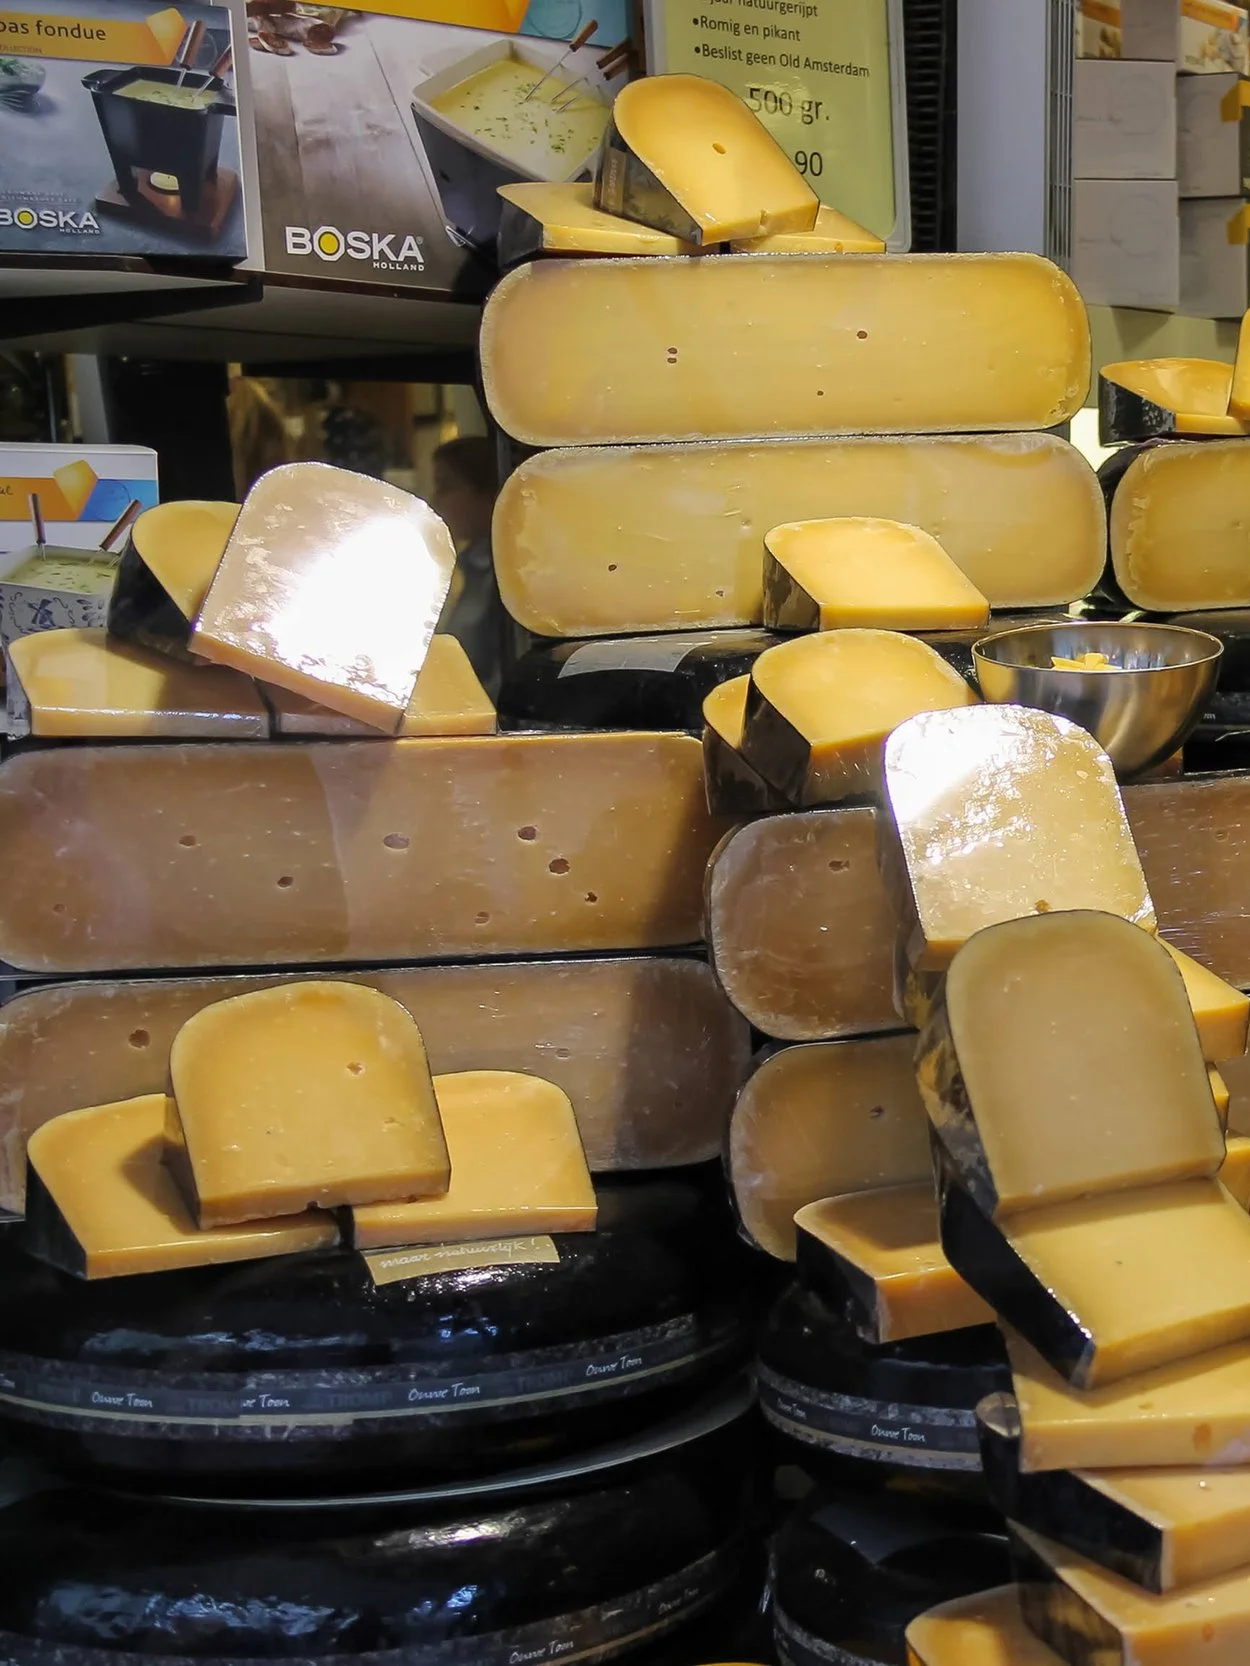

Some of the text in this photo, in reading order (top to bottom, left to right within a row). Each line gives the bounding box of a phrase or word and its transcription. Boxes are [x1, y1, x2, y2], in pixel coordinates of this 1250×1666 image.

[36, 20, 107, 41] fondue
[700, 15, 801, 42] Romig en pikant
[702, 44, 870, 78] Beslist geen Old Amsterdam
[749, 87, 830, 125] 500 gr.
[794, 150, 823, 177] 90
[0, 207, 100, 229] BOSKA
[285, 225, 425, 263] BOSKA
[372, 261, 425, 272] HOLLAND
